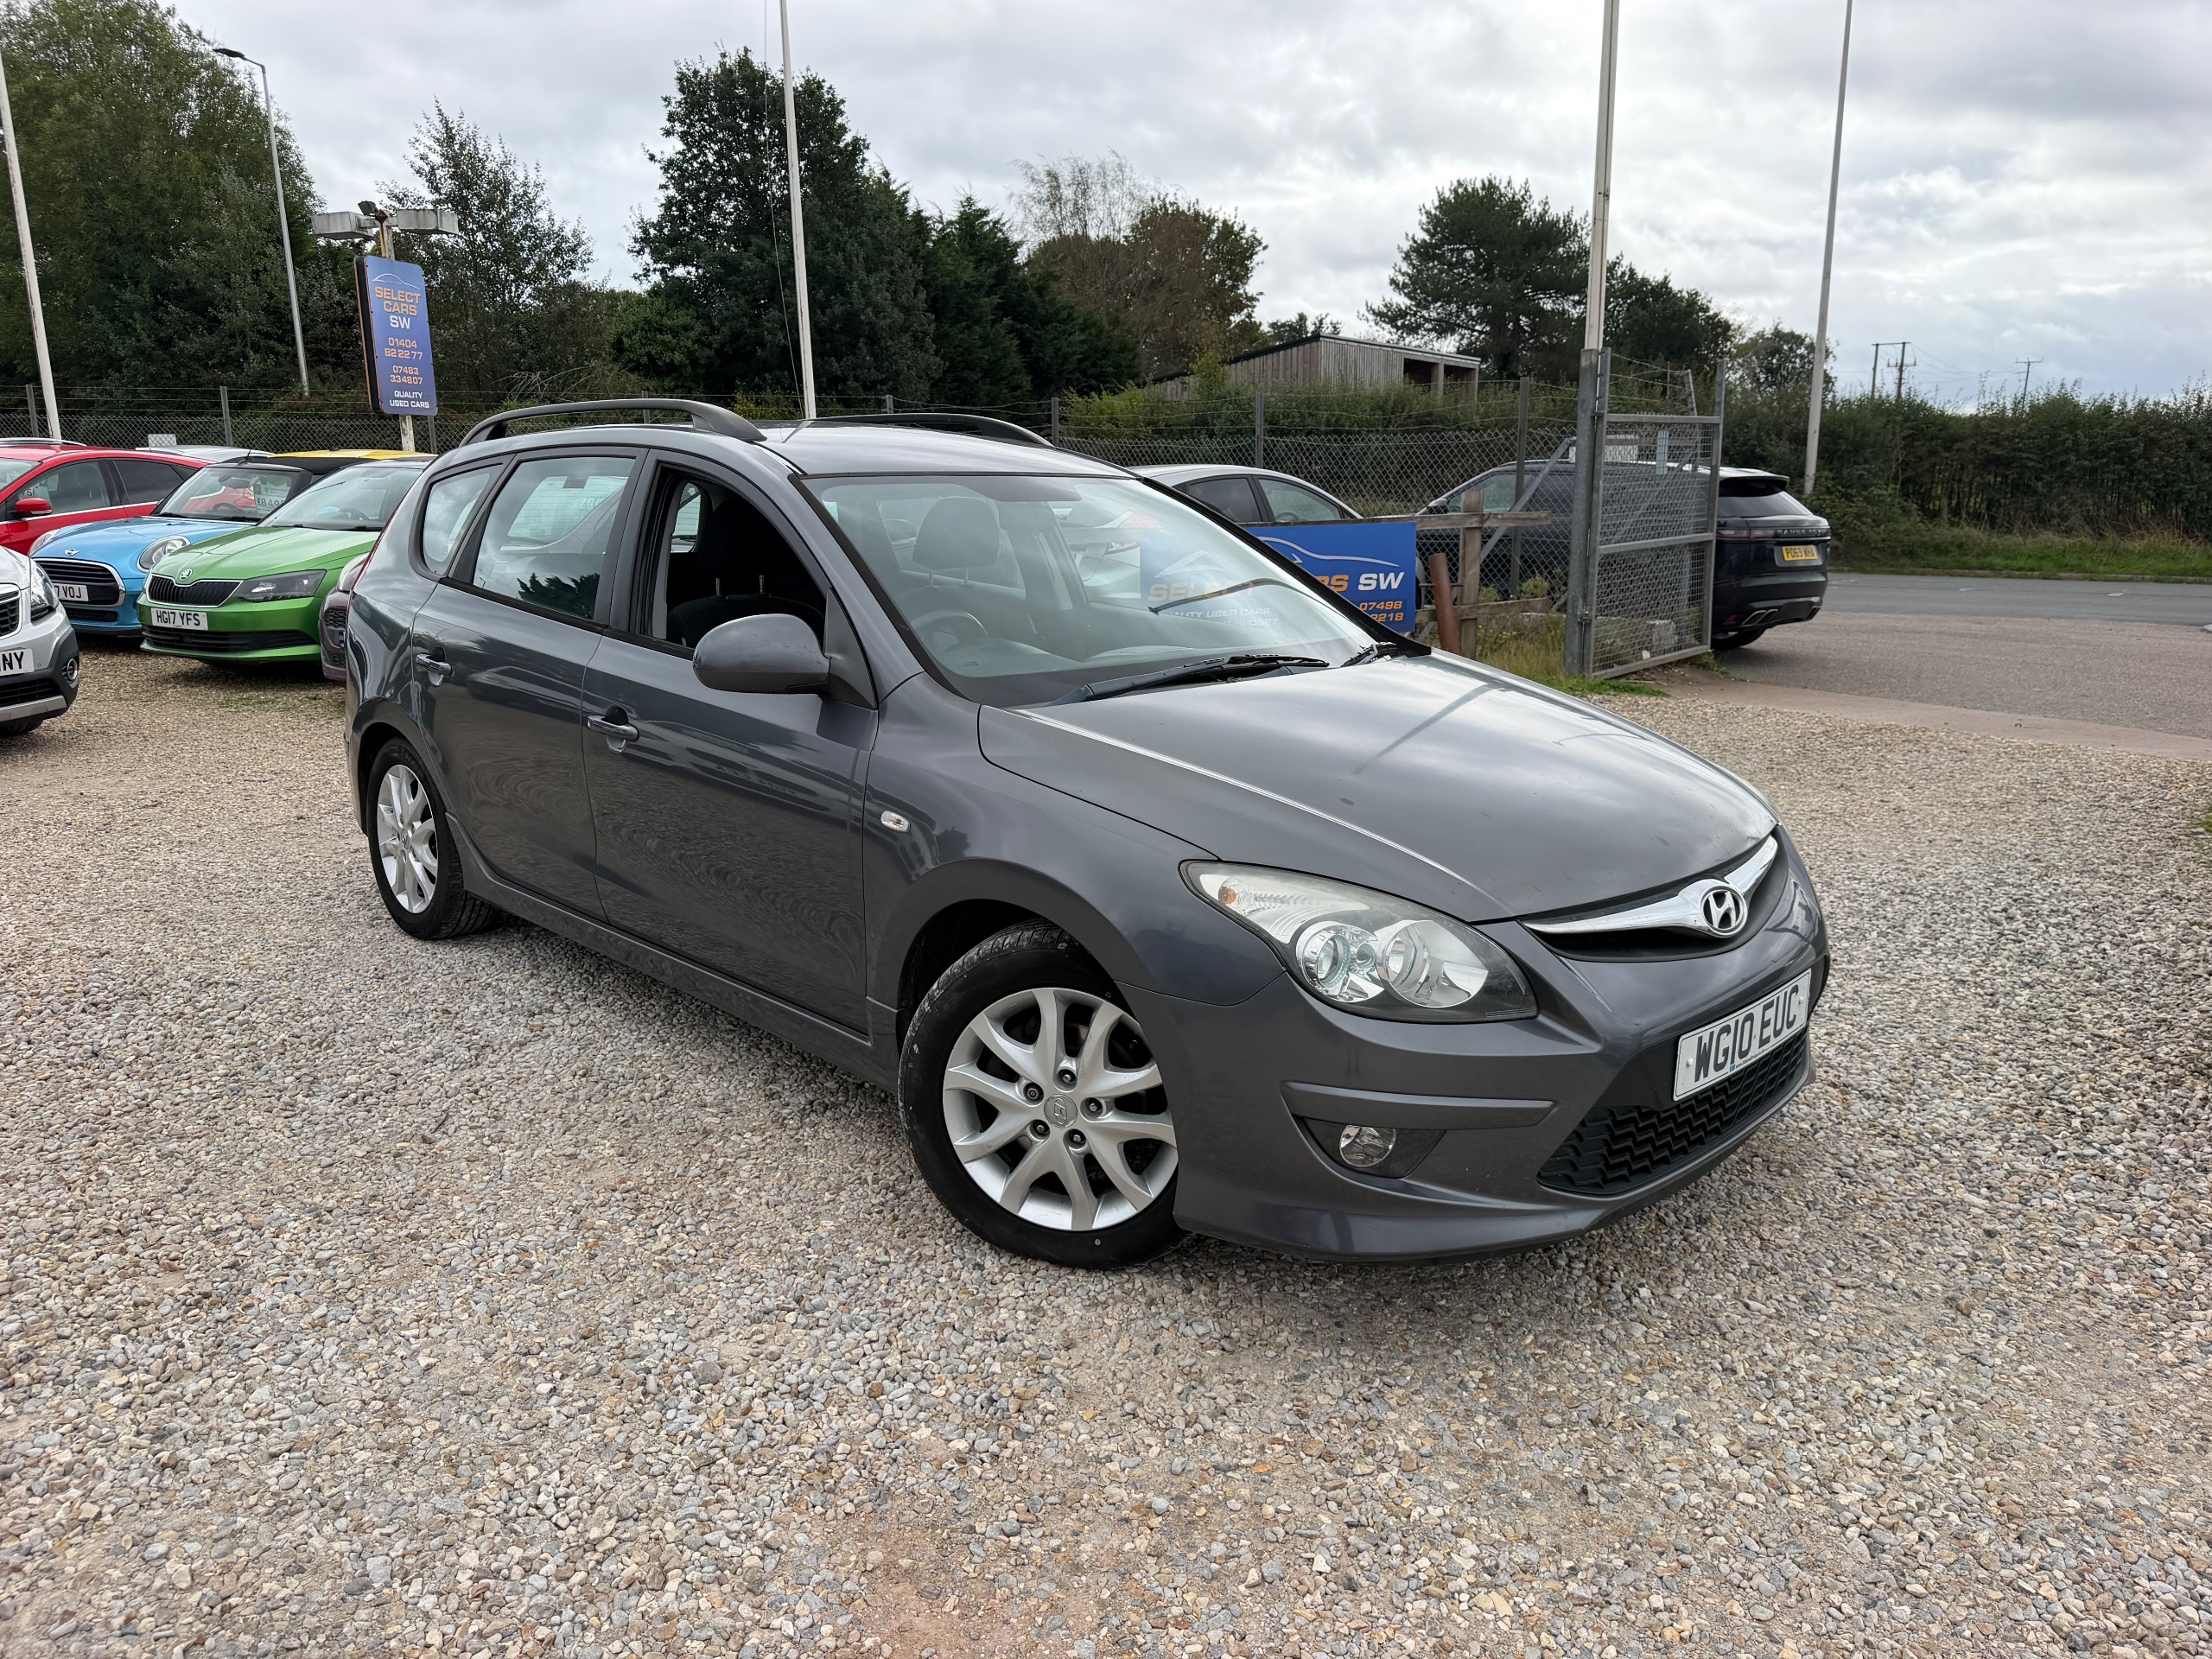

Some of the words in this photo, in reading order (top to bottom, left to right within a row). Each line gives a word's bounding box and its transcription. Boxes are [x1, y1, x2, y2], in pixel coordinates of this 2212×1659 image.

[374, 286, 421, 304] SELECT
[383, 301, 417, 316] CARS
[389, 315, 411, 329] SW
[388, 337, 417, 349] 01404
[392, 365, 419, 375] 07483
[390, 374, 423, 385] 334807
[394, 390, 423, 399] QUALITY
[410, 400, 430, 409] CARS
[1357, 572, 1405, 591] SW
[62, 585, 82, 599] VOJ
[1206, 609, 1237, 618] USED
[1240, 607, 1271, 616] CARS
[1359, 601, 1403, 612] 07498
[156, 609, 176, 625] HG17
[179, 612, 200, 626] YFS
[0, 651, 24, 672] NY
[1694, 1012, 1755, 1084] WG10
[1758, 983, 1800, 1049] EUC
